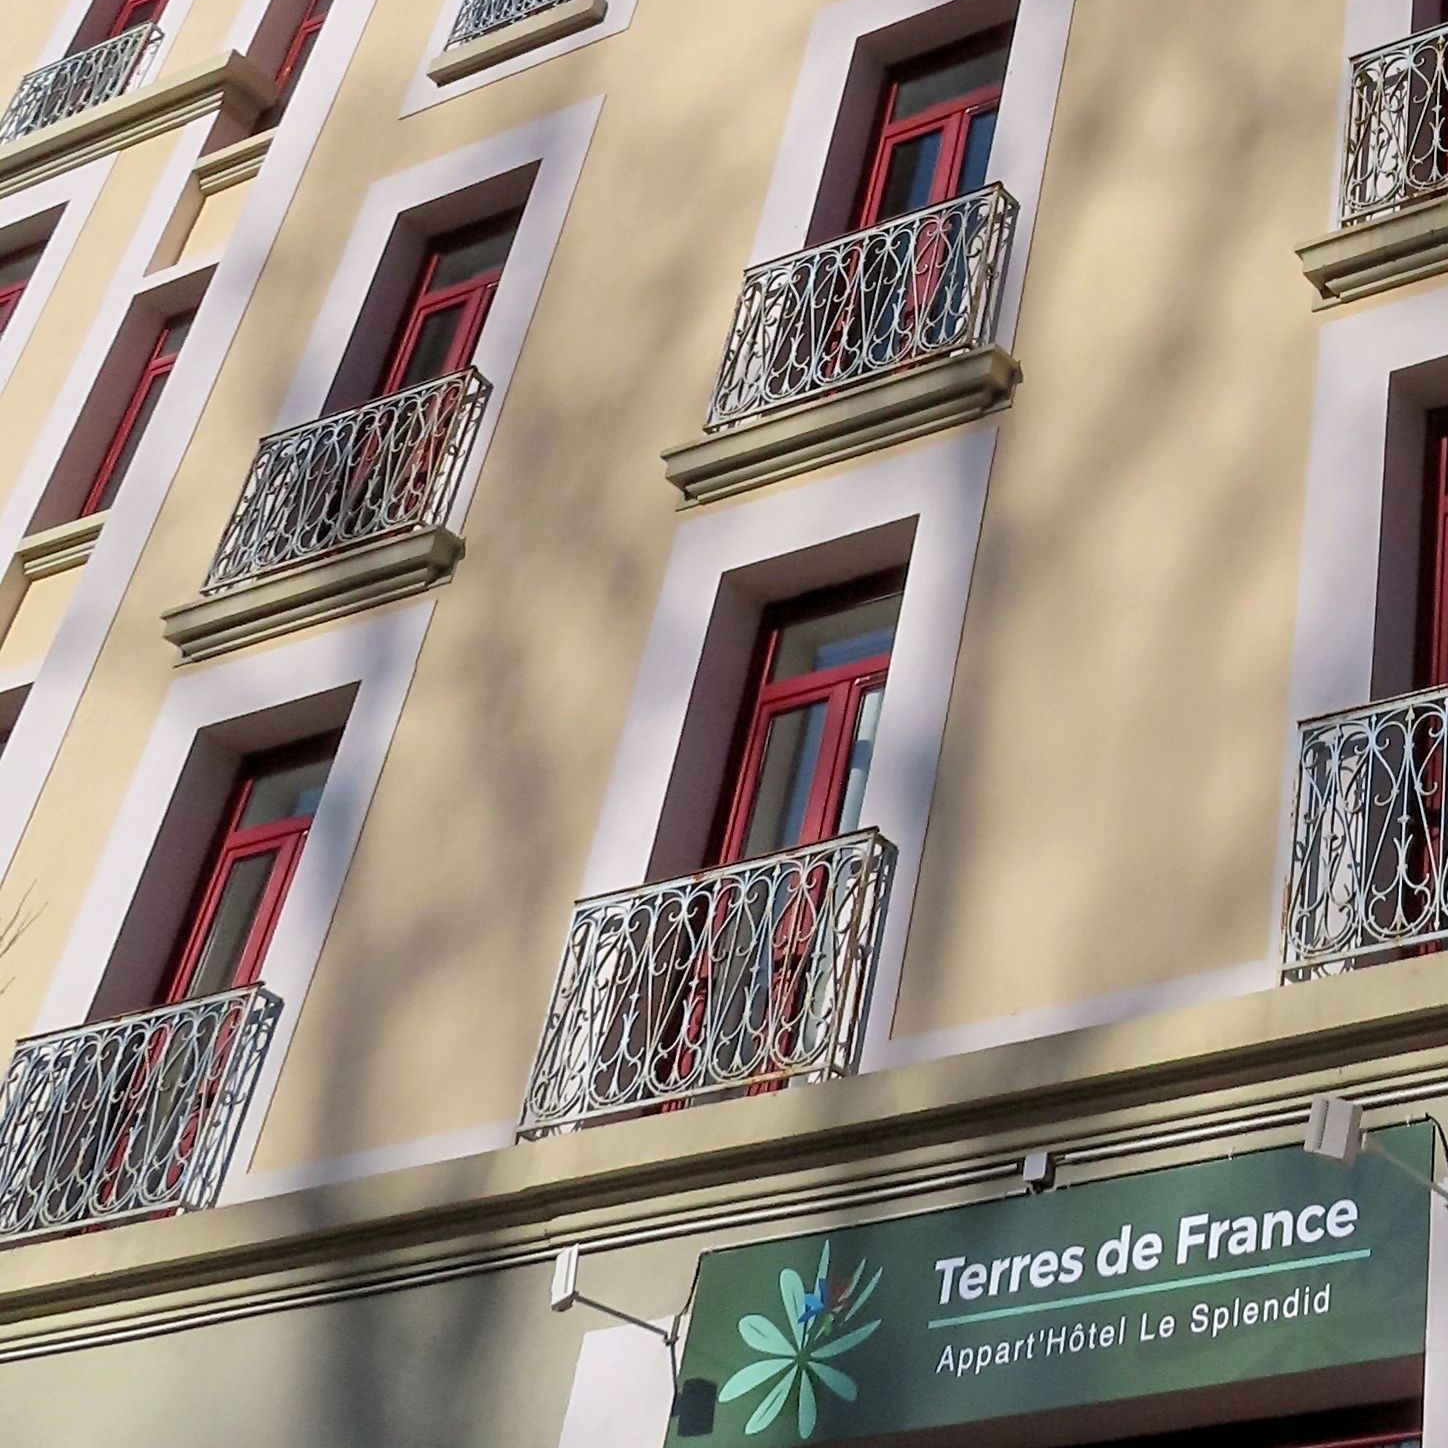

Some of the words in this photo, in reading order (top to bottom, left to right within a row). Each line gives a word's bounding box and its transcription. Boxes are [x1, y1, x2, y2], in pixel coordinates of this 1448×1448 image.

[935, 1244, 1085, 1305] Terres
[1097, 1225, 1161, 1277] de
[1177, 1196, 1359, 1266] France
[936, 1316, 1125, 1376] Appart'Hôtel
[1140, 1315, 1176, 1342] Le
[1190, 1284, 1332, 1335] Splendid
